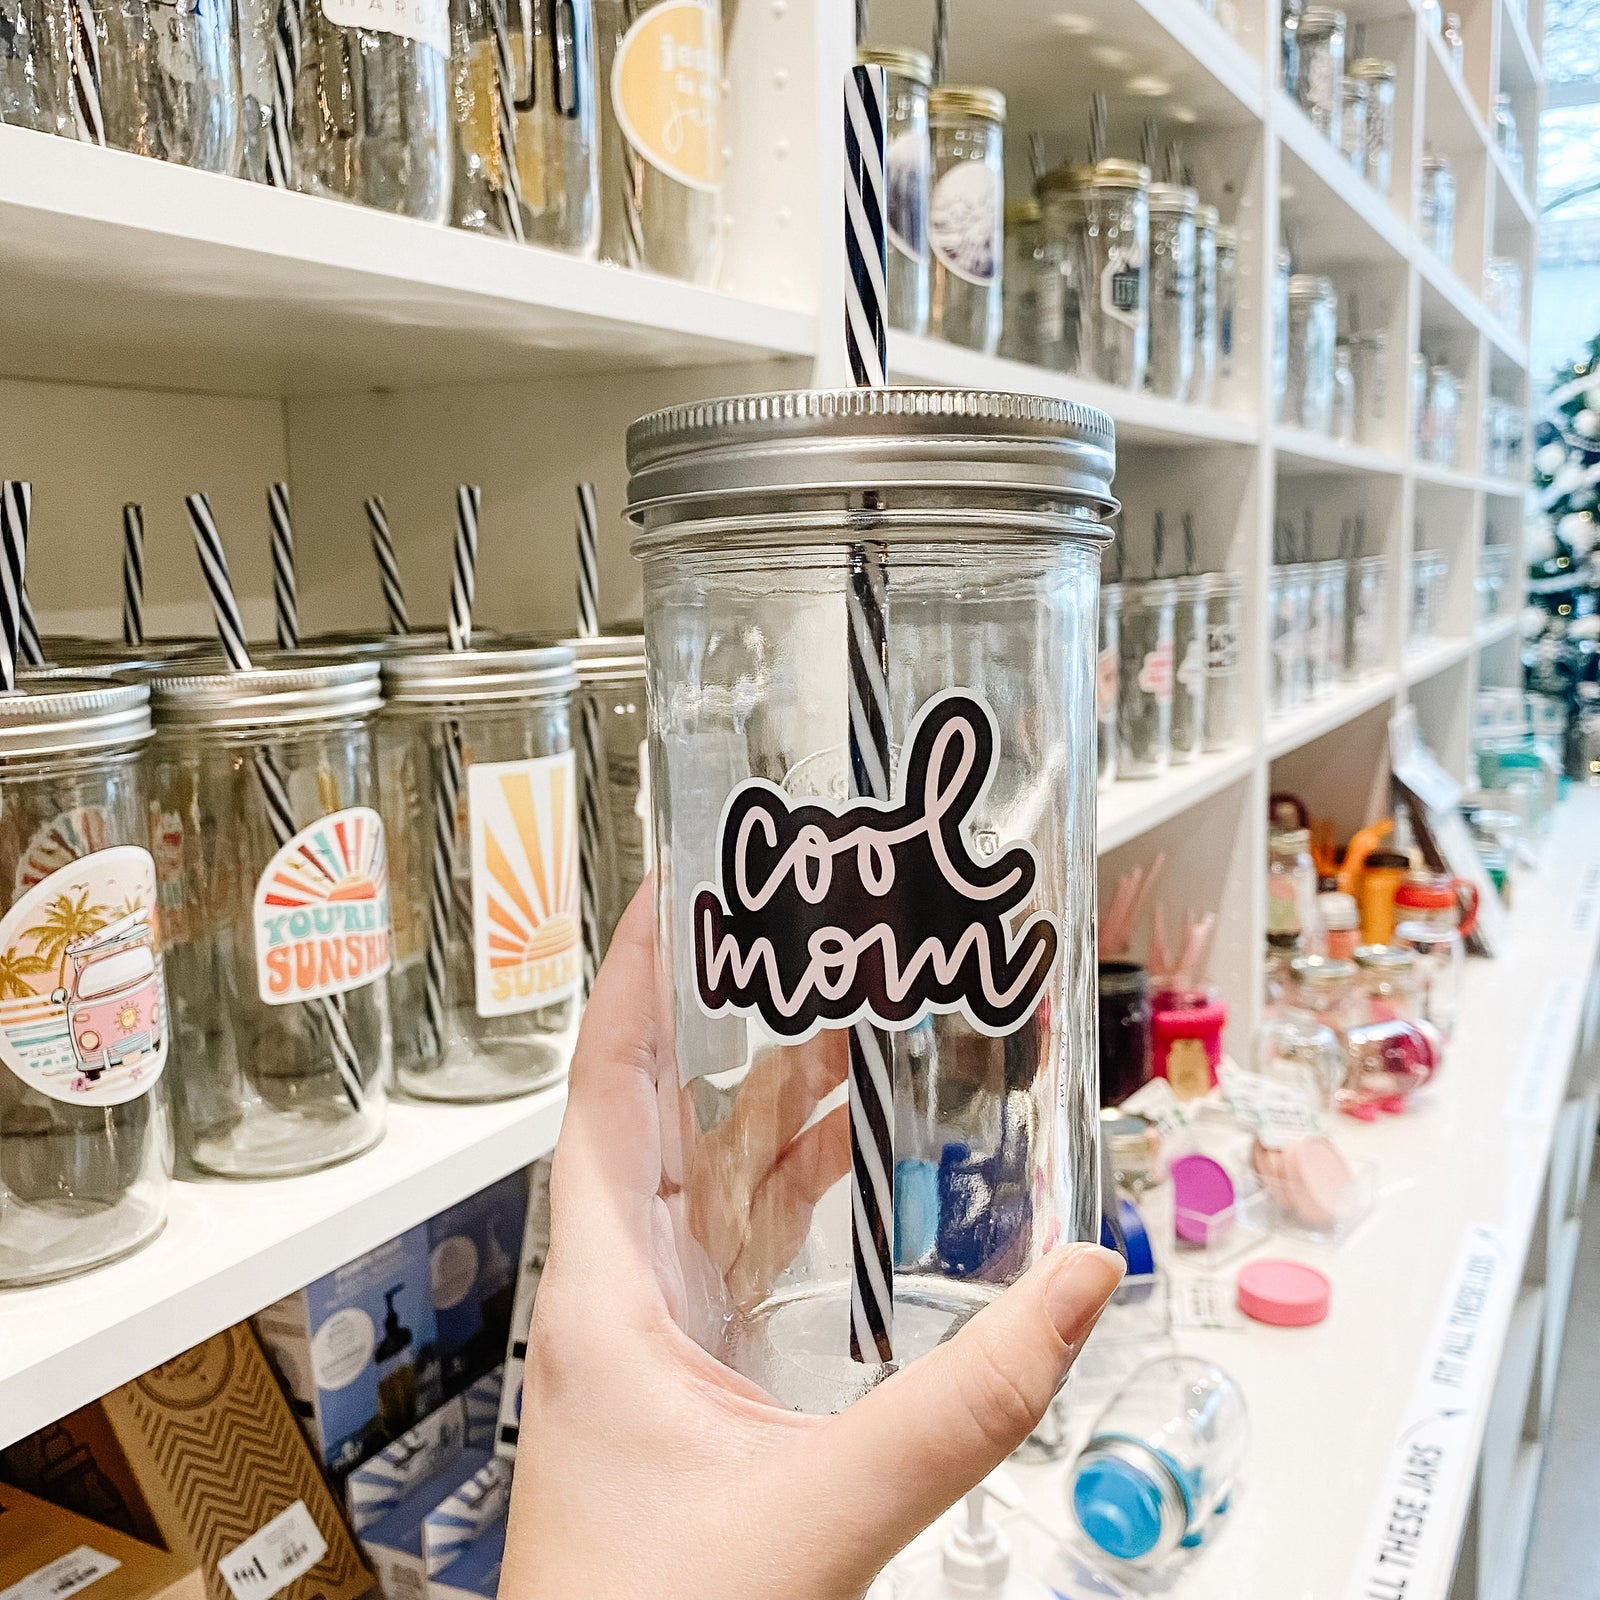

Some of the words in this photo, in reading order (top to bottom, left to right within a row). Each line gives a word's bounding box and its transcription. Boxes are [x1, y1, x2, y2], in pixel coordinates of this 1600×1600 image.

[735, 715, 1022, 912] cool
[264, 905, 375, 945] YOU'RE
[703, 908, 1047, 1018] mom
[1399, 1444, 1443, 1496] JARS
[1379, 1498, 1428, 1567] THESE
[1367, 1577, 1406, 1600] LL
